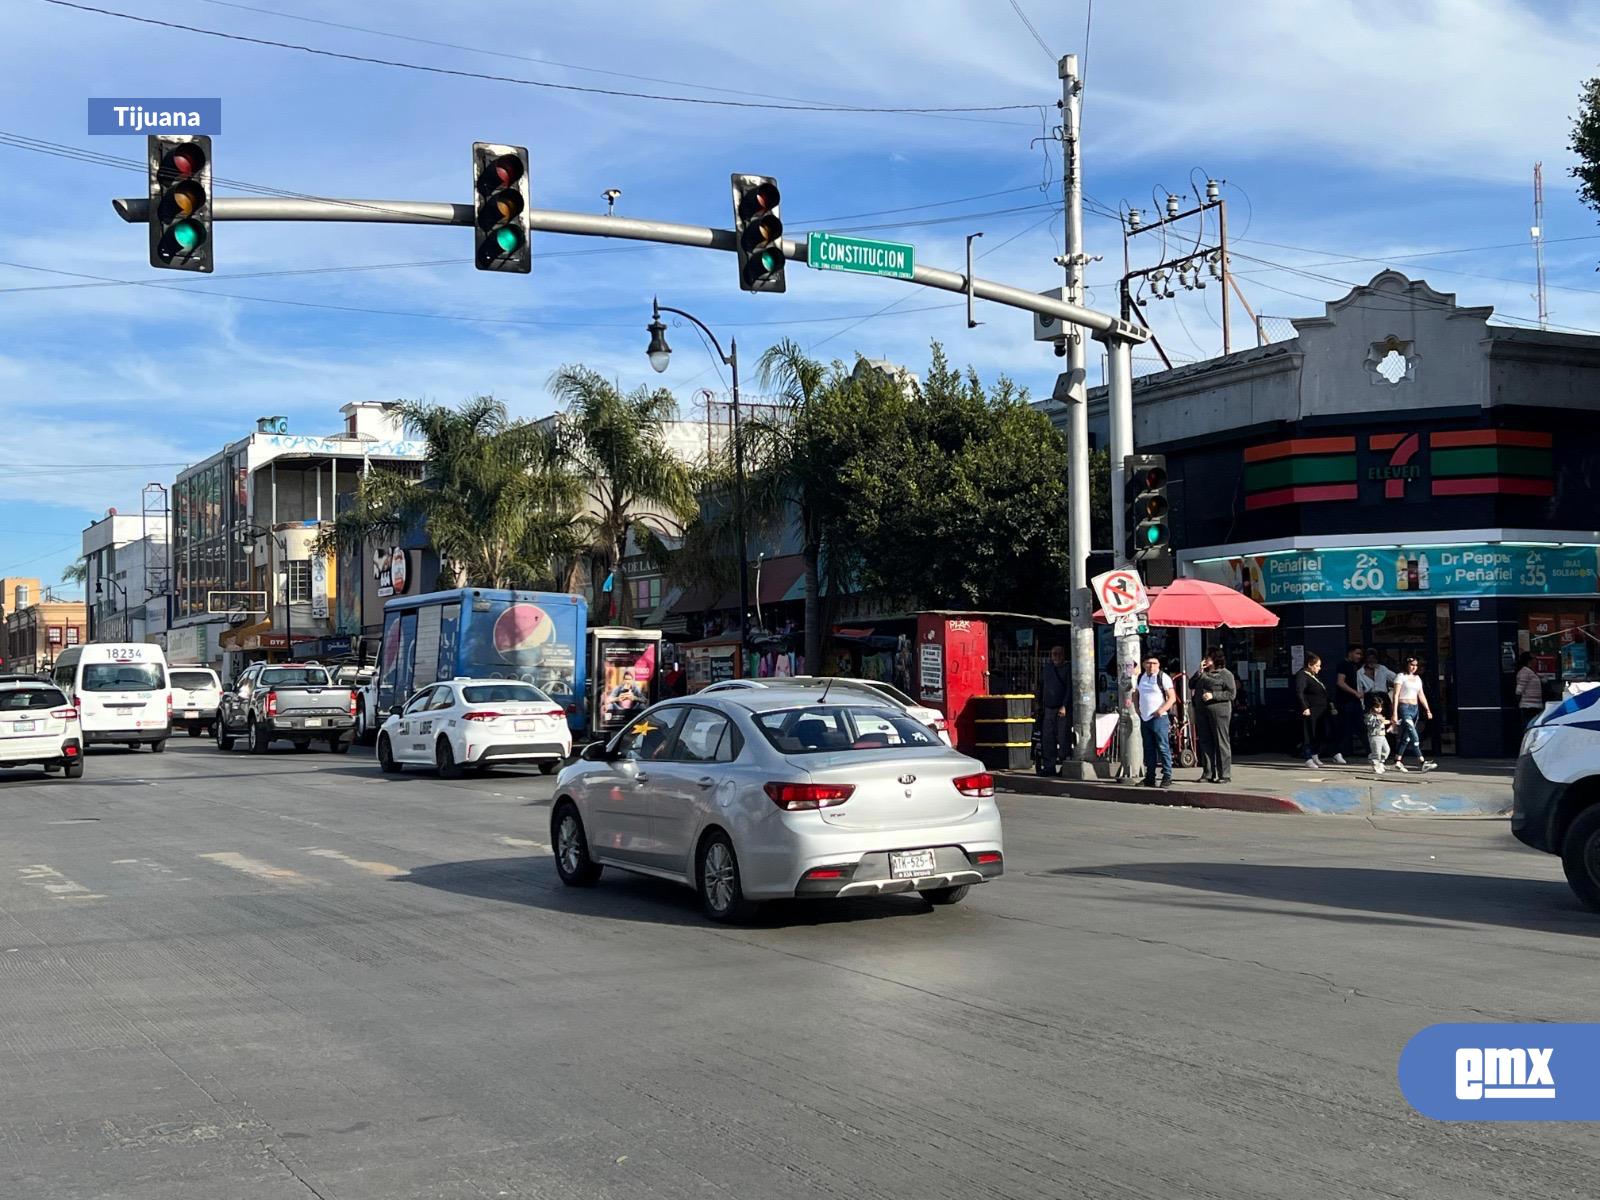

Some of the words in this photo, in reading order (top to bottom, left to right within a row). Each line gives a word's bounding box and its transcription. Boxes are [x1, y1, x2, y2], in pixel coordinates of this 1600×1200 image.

[820, 242, 905, 269] CONSTITUCION
[1369, 432, 1419, 498] 7
[628, 561, 638, 572] DE
[640, 560, 650, 571] LA
[1270, 556, 1321, 573] Peñafiel
[1356, 553, 1378, 569] 2x
[1442, 552, 1460, 565] Dr
[1463, 551, 1512, 567] Pepper
[1343, 568, 1384, 591] $60
[1445, 575, 1452, 585] y
[1455, 568, 1513, 582] Peñafiel
[1520, 564, 1546, 586] $35
[1270, 582, 1281, 594] Dr
[1283, 581, 1325, 595] Pepper
[106, 648, 142, 659] 18234
